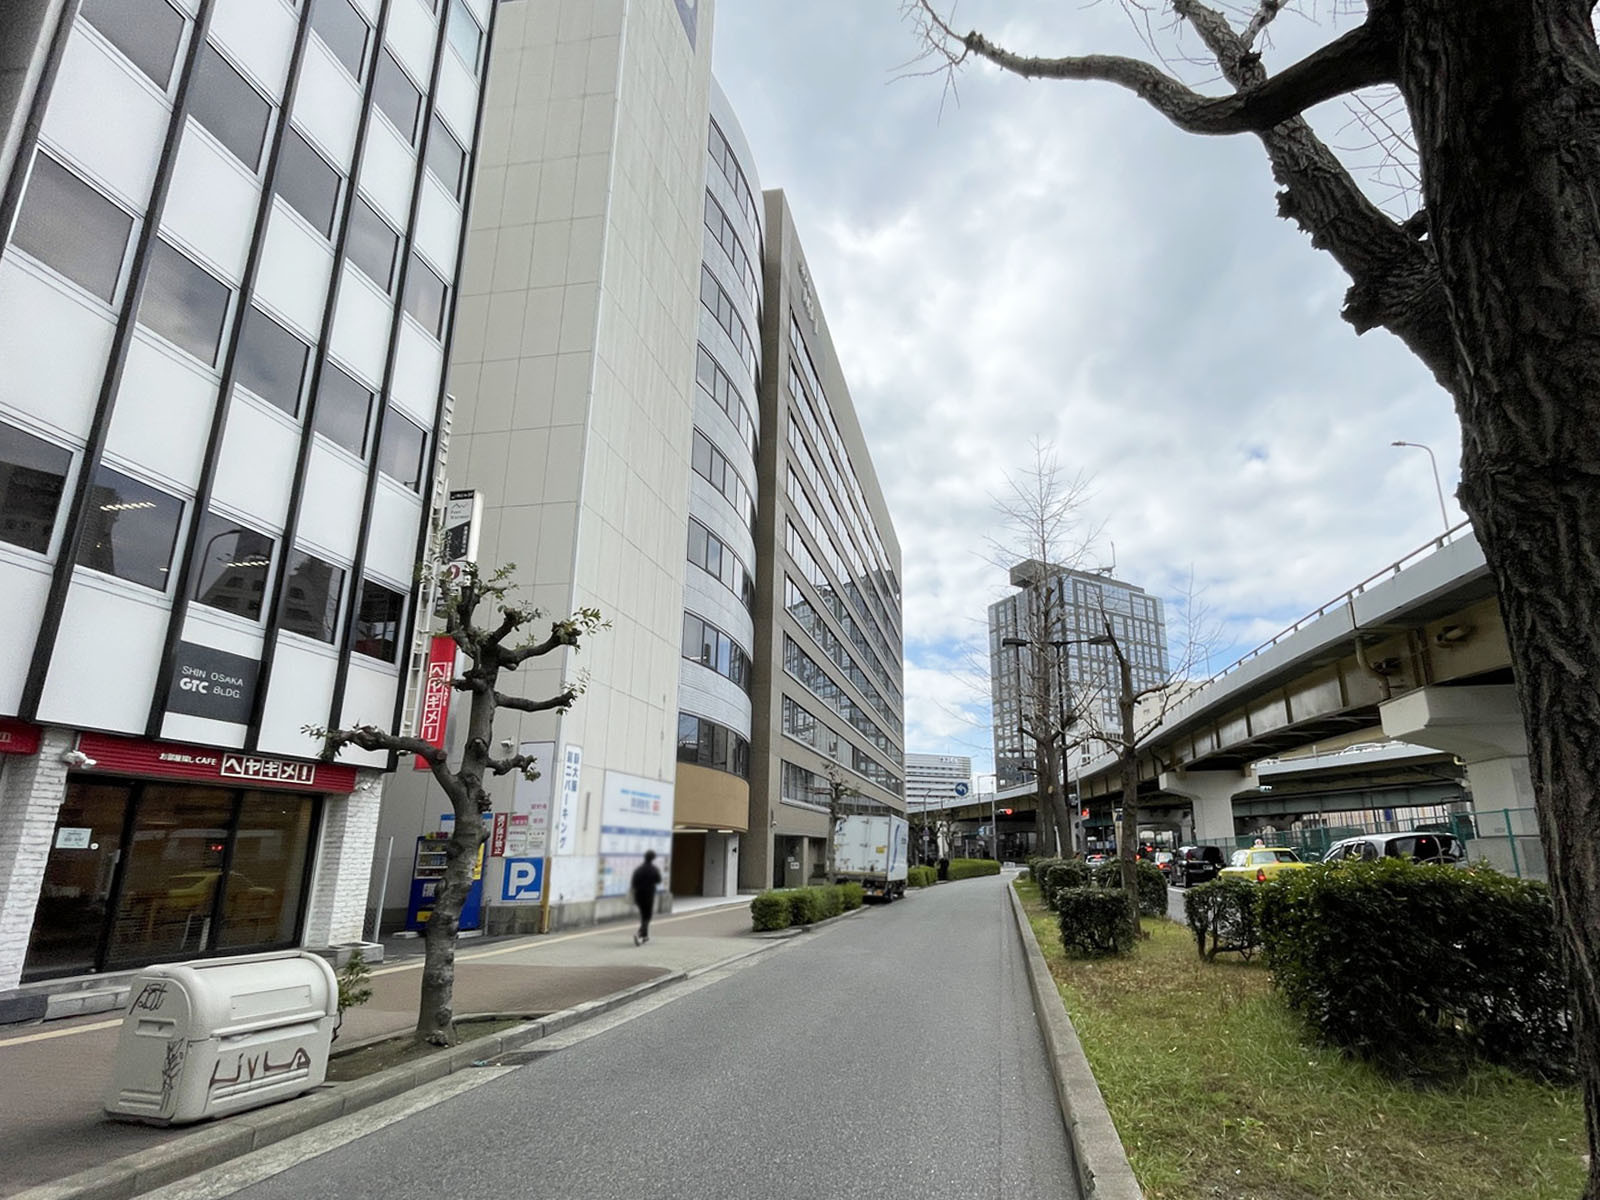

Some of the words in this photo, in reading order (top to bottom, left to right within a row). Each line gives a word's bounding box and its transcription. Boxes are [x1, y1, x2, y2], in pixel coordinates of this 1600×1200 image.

[179, 677, 209, 694] GTC
[181, 665, 207, 679] SHIN
[210, 672, 244, 687] OSAKA
[195, 756, 217, 766] CAFE
[508, 861, 537, 897] P
